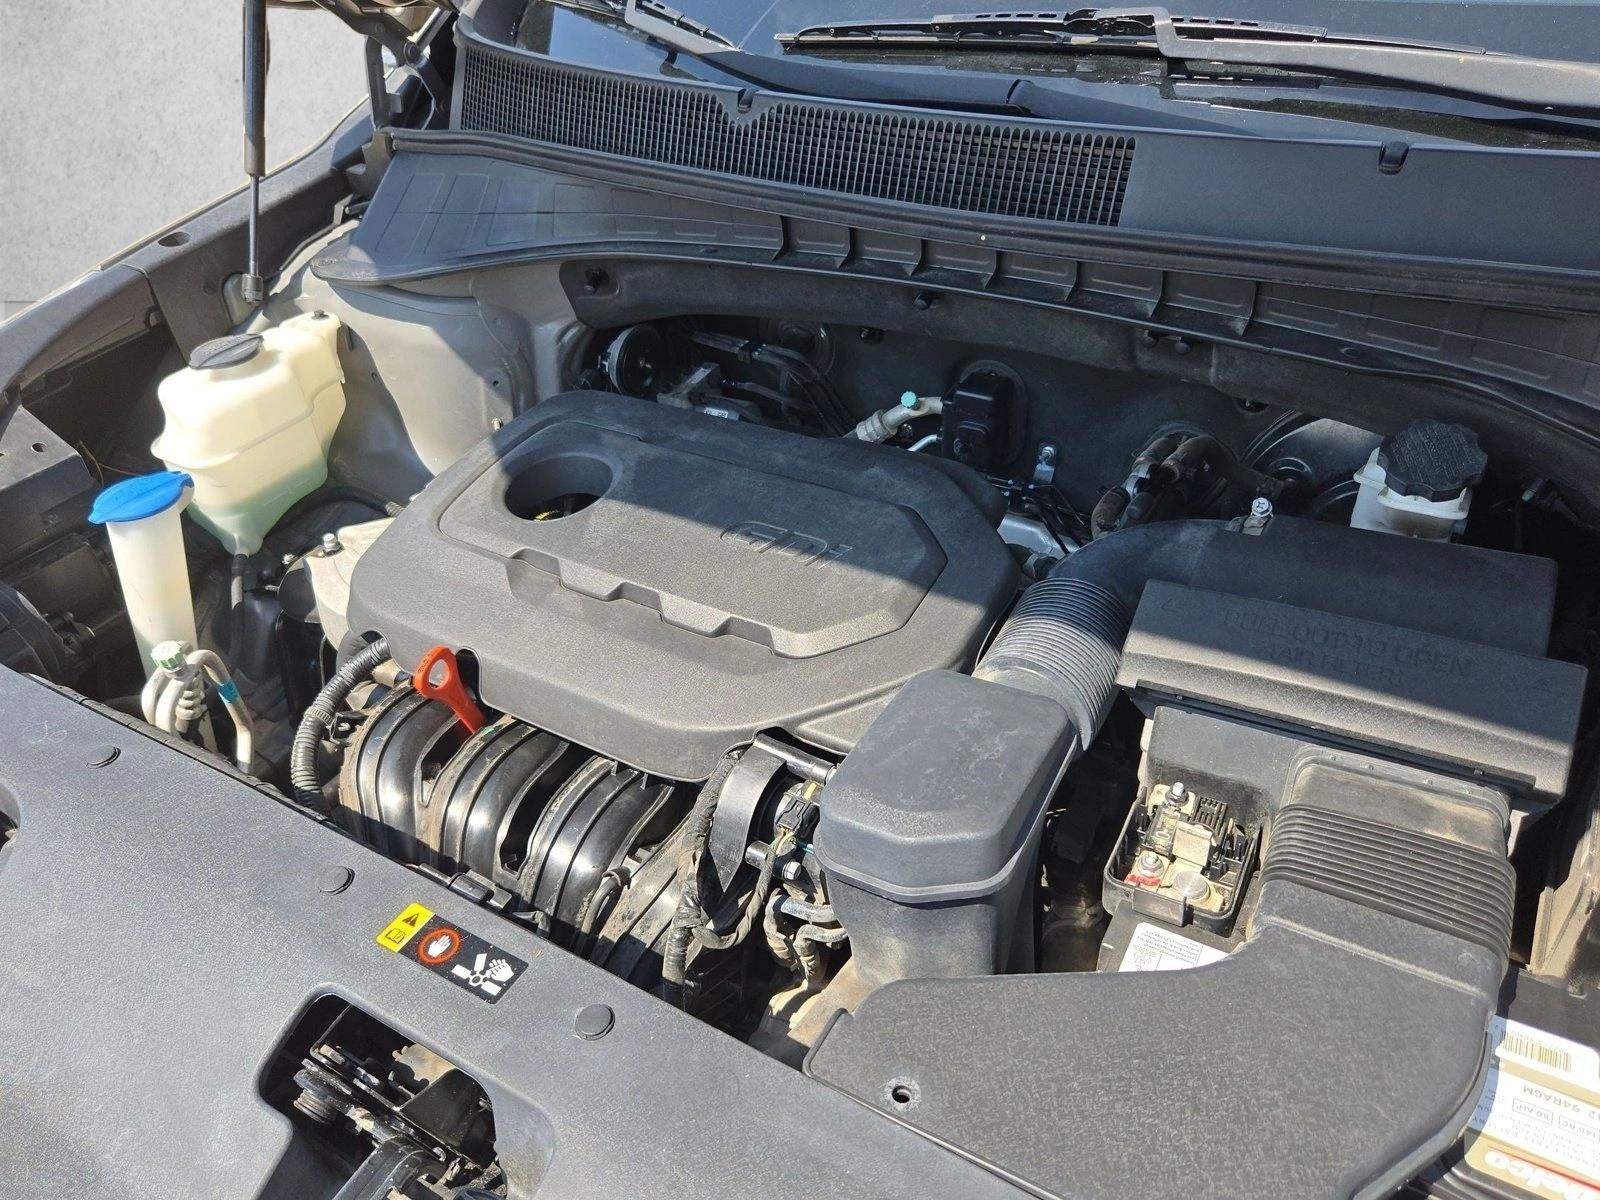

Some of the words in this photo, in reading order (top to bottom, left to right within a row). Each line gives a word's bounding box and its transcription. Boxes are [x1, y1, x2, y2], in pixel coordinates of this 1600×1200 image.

[1224, 608, 1284, 638] PULL
[1292, 621, 1347, 649] OUT
[1394, 641, 1472, 677] OPEN
[1523, 1085, 1581, 1113] 94RAGM
